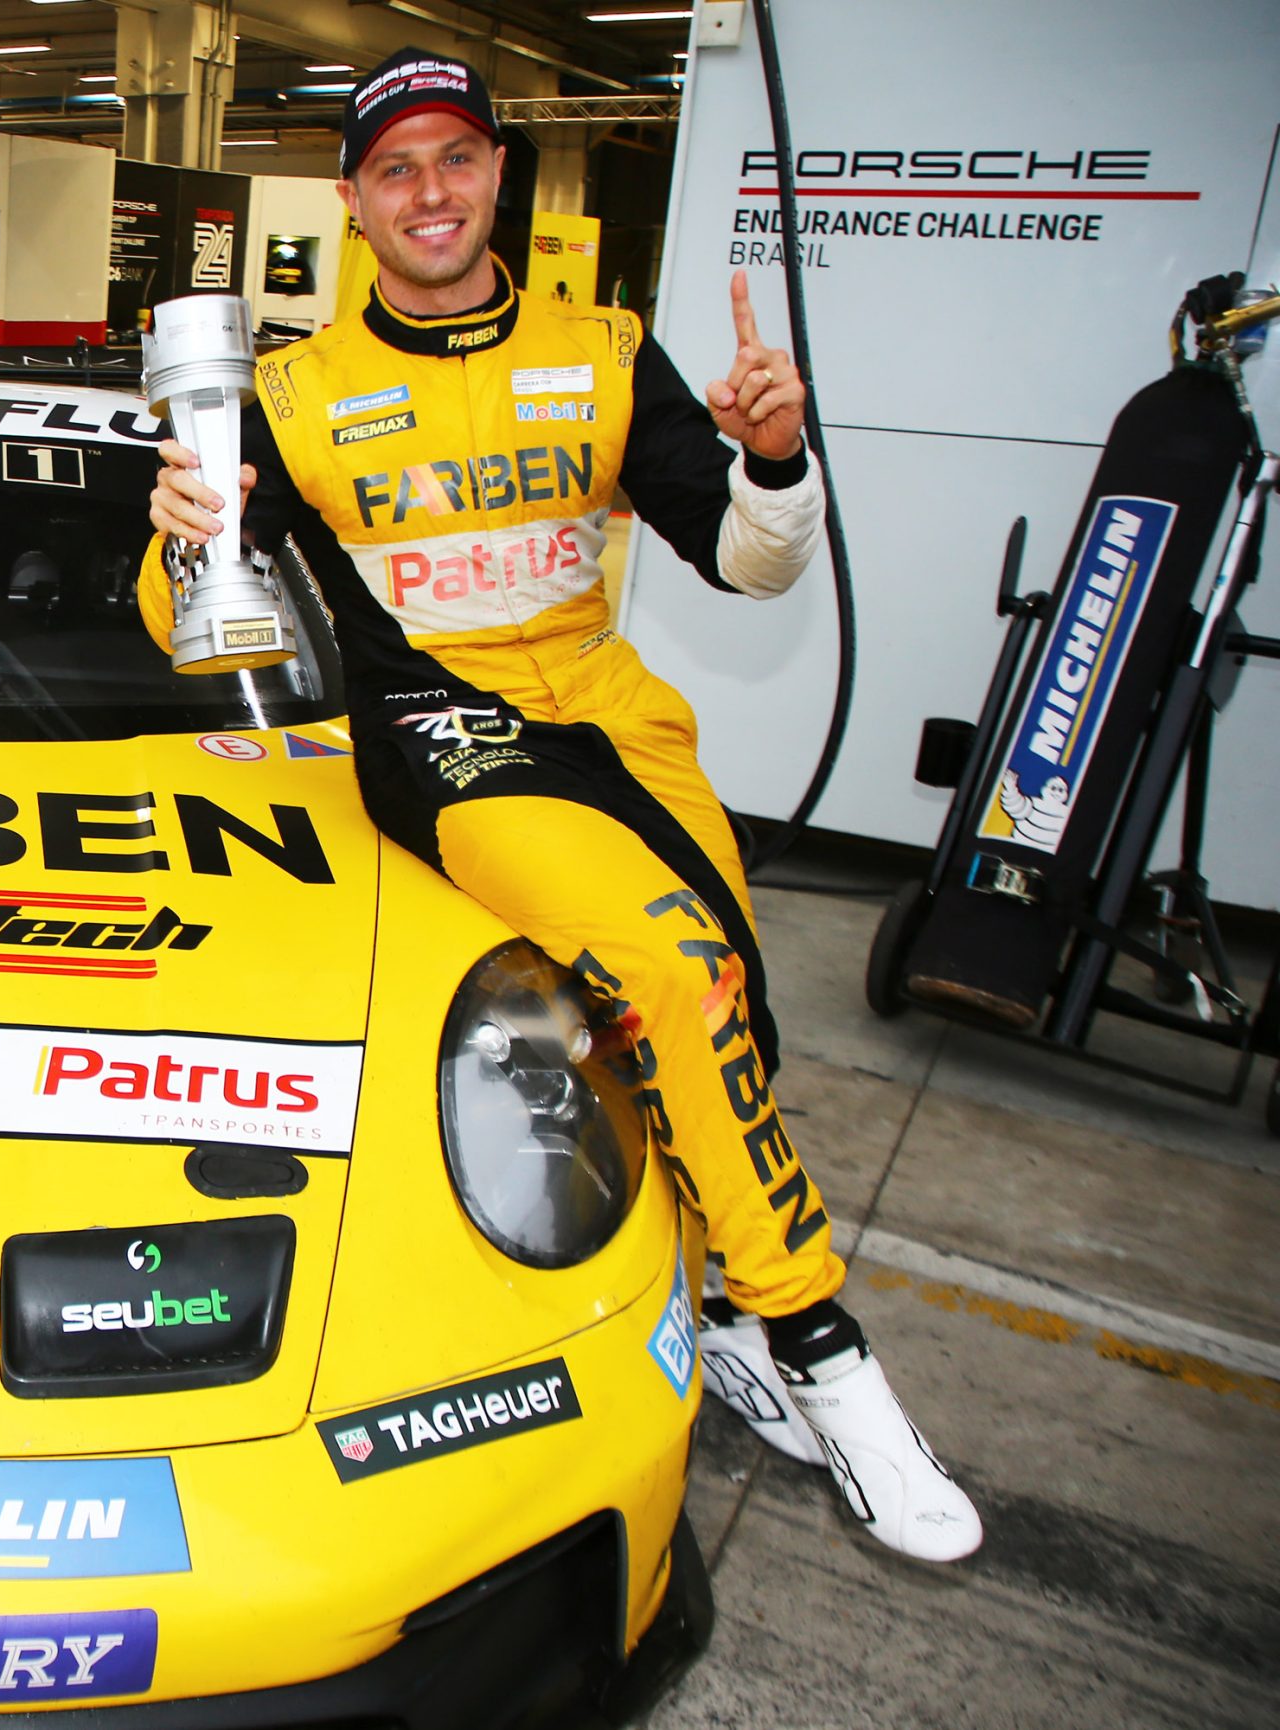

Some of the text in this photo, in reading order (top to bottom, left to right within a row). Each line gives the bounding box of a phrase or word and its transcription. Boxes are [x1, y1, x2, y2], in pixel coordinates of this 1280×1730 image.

[355, 60, 468, 108] PORSCHE
[740, 149, 1152, 180] PORSCHE
[732, 209, 1104, 241] ENDURANCE CHALLENGE
[448, 324, 499, 350] FARBEN
[349, 390, 404, 410] MICHELIN
[517, 401, 577, 421] Mobil
[338, 414, 409, 444] FREMAX
[352, 442, 593, 528] FARBEN
[390, 527, 581, 608] Patrus
[226, 632, 259, 647] Mobil
[1028, 507, 1144, 766] MICHELIN
[42, 1046, 320, 1113] Patrus
[61, 1287, 231, 1333] seubet
